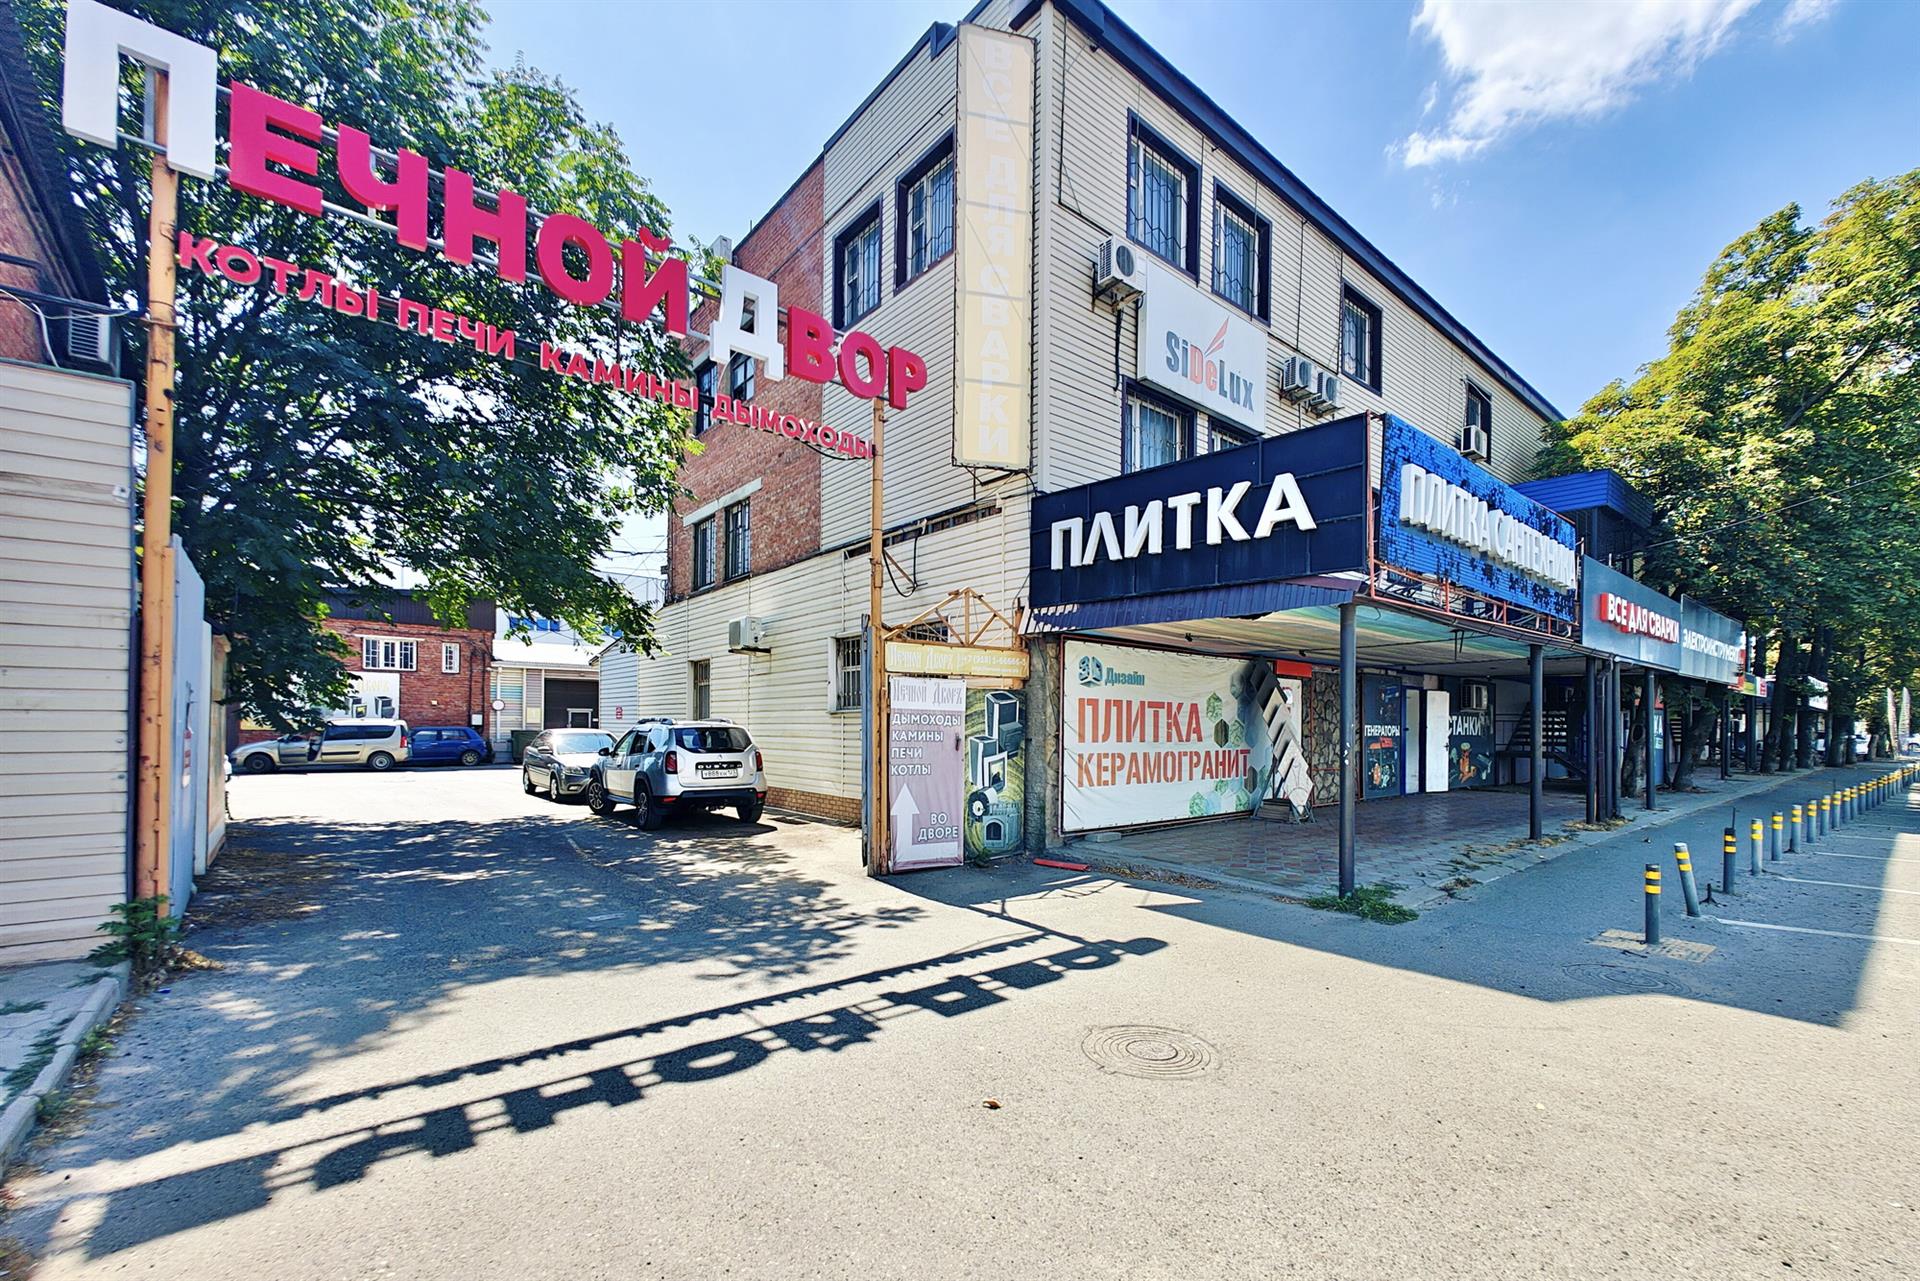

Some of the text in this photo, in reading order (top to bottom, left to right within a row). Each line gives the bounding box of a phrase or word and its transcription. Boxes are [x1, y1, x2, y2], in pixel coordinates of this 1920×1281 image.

[63, 0, 927, 411] ПЕЧНОЙ ДВОР
[178, 231, 876, 459] КОТЛЫ ПЕЧИ КАМИНЫ ДЫМОХОДЫ
[978, 264, 1010, 456] СВАРКИ
[1050, 472, 1317, 571] ПЛИТКА
[1401, 463, 1576, 591] ПЛИТКА САНТЕХНИКА
[1607, 593, 1680, 643] ВСЕ ДЛЯ СВАРКИ
[1105, 667, 1145, 686] Дизайн
[892, 714, 961, 726] ДЫМОХОДЫ
[1077, 697, 1203, 743] ПЛИТКА
[1364, 725, 1400, 736] ГЕНЕРАТОРЫ
[1449, 715, 1481, 736] СТАНКИ
[892, 730, 944, 742] КАМИНЫ
[891, 747, 922, 759] ПЕЧИ
[891, 764, 931, 776] КОТЛЫ
[1077, 749, 1251, 787] КЕРАМОГРАНИТ
[930, 812, 947, 824] ВО
[918, 826, 959, 841] ДВОРЕ
